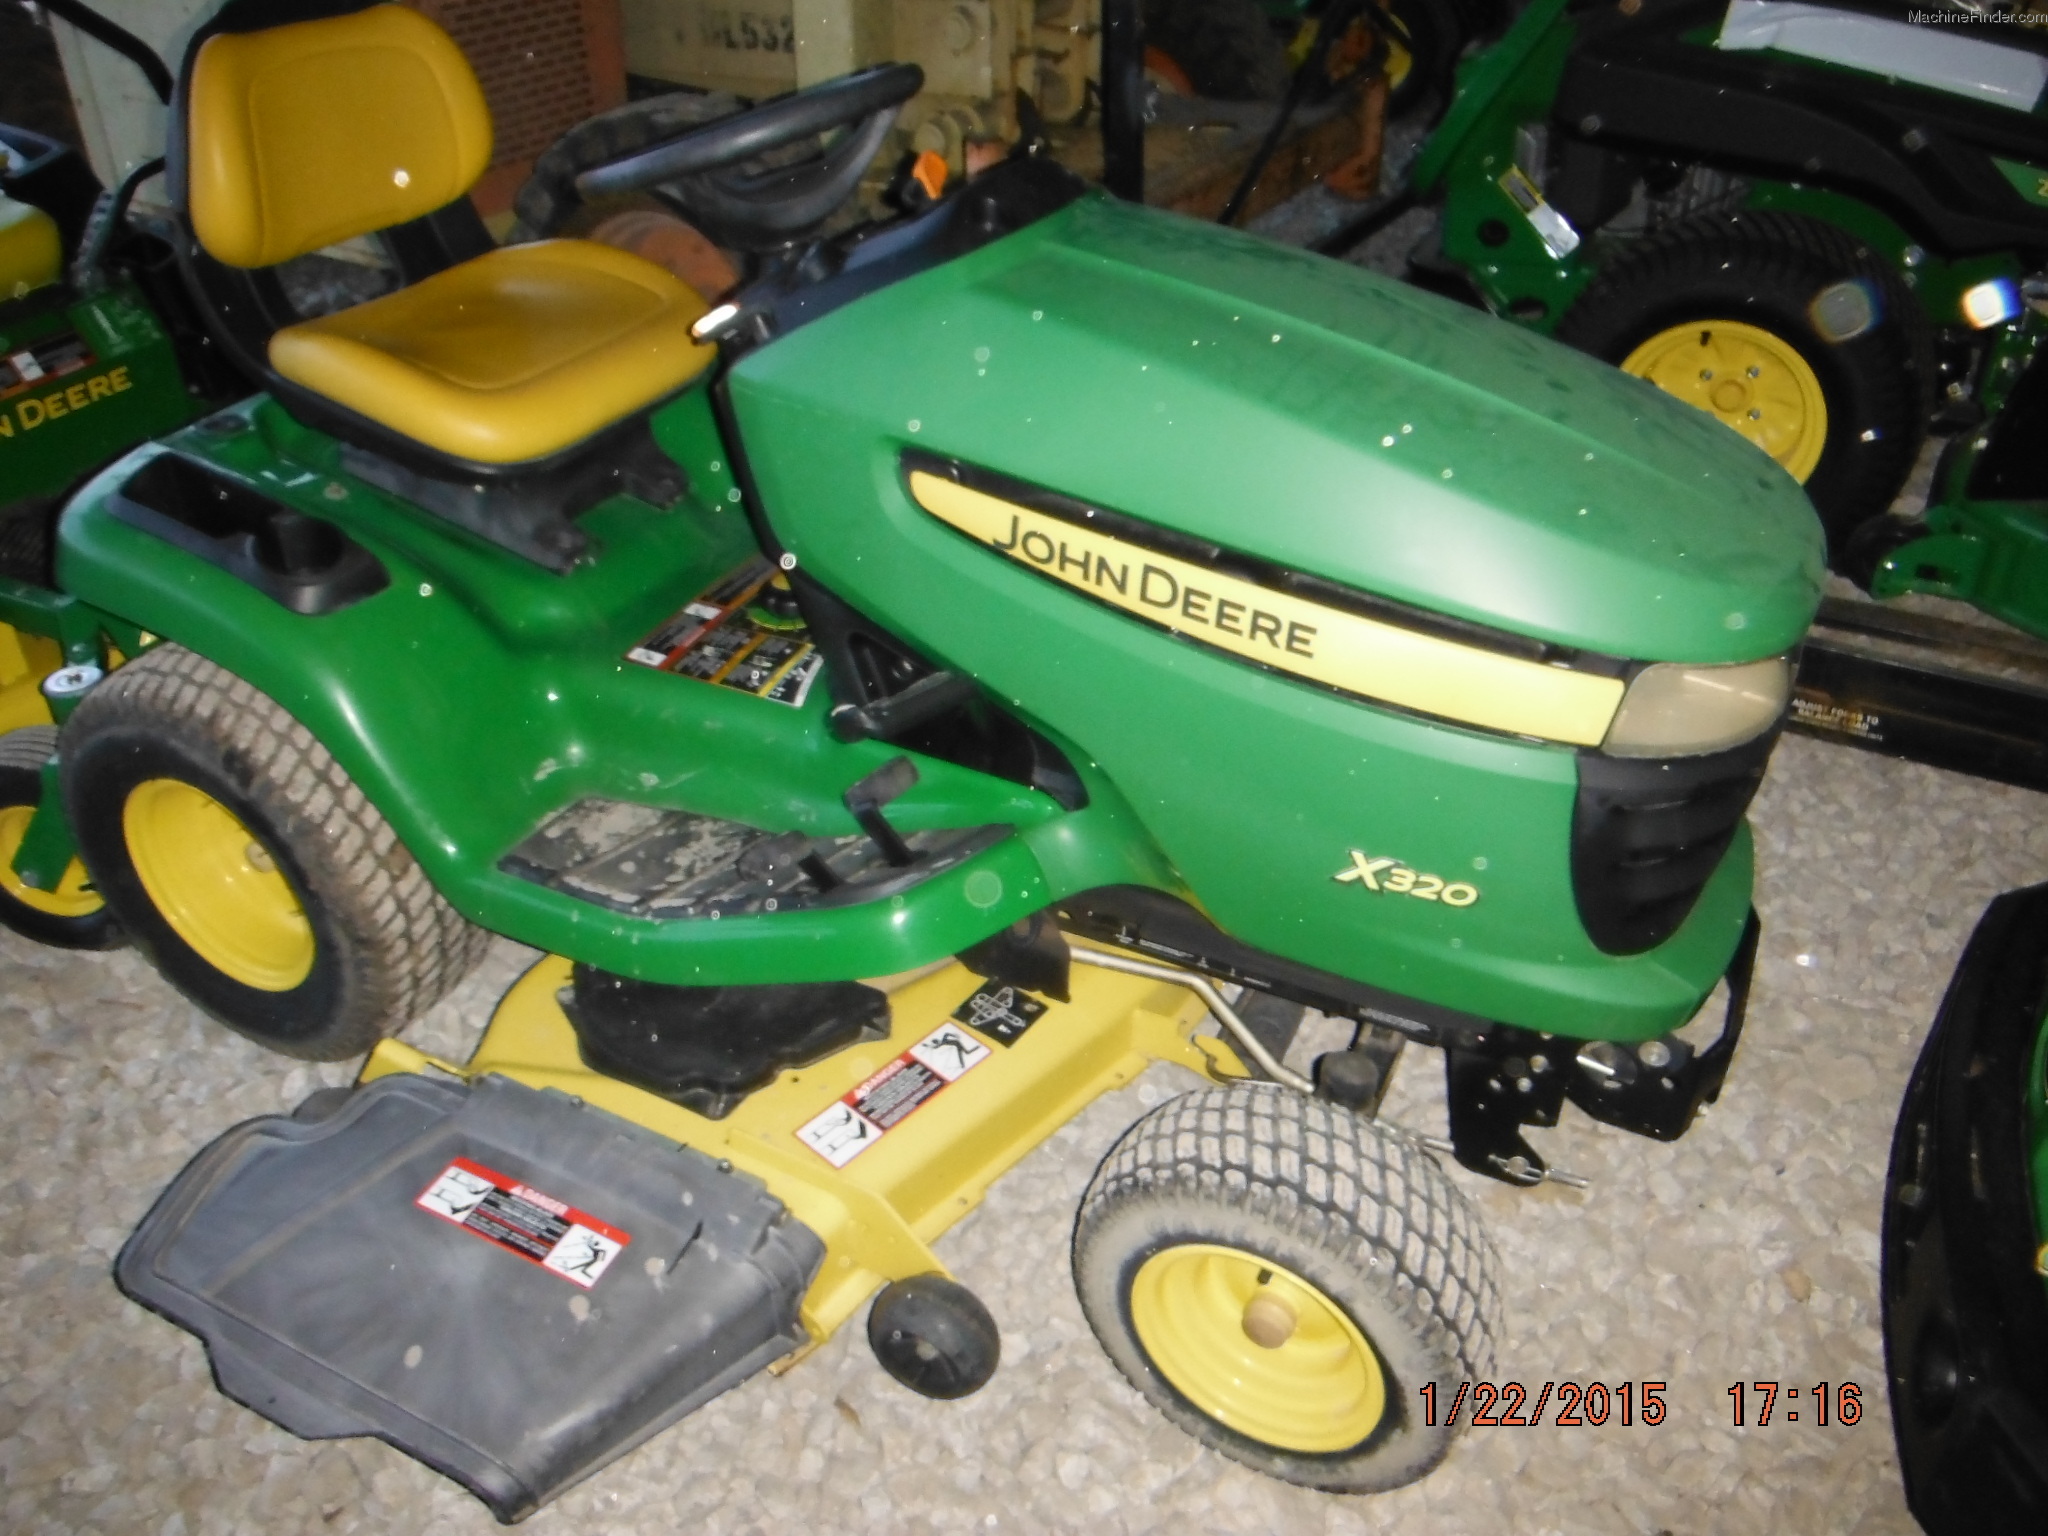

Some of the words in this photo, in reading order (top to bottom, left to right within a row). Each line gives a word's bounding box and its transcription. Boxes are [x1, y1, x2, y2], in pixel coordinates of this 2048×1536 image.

[16, 365, 133, 431] DEERE
[993, 515, 1129, 596] JOHN
[1139, 563, 1317, 659] DEERE
[1332, 848, 1480, 907] X320
